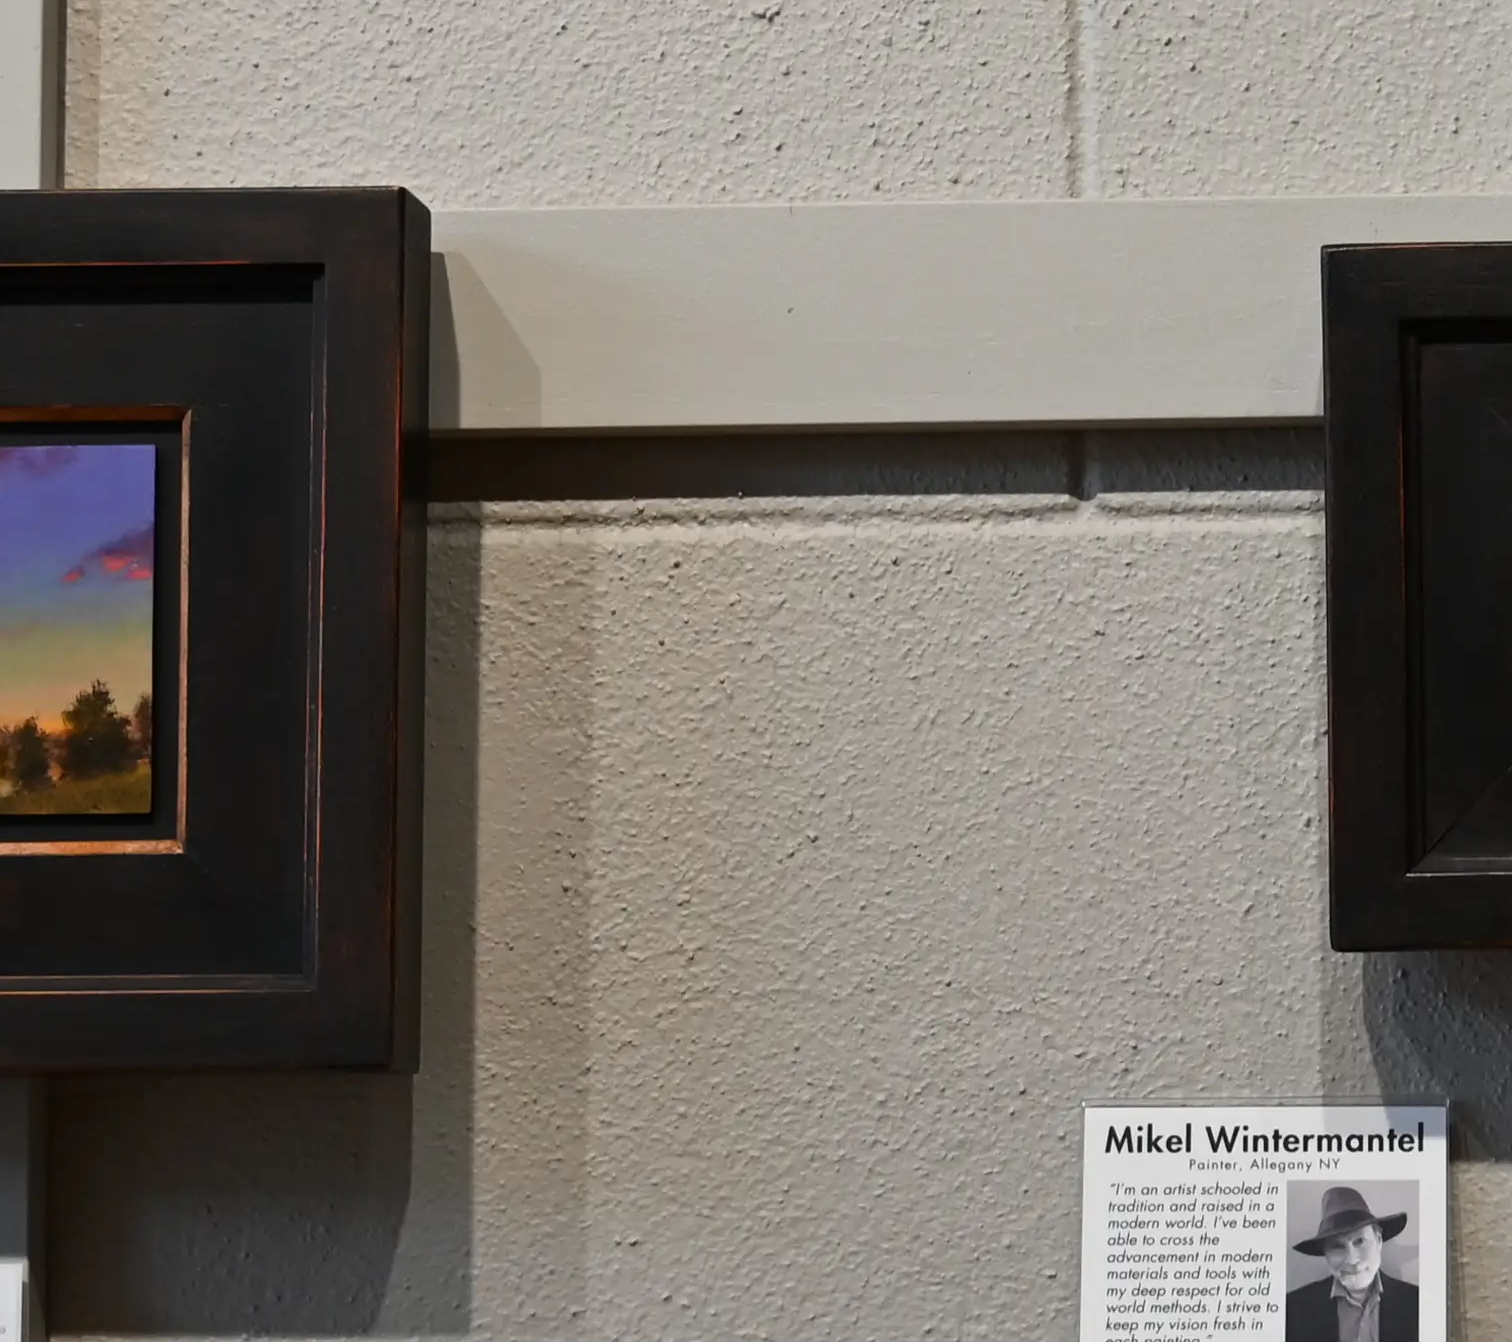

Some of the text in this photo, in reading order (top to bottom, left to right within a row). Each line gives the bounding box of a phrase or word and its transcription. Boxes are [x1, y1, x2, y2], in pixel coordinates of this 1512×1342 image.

[1104, 1122, 1424, 1153] Mikel Wintermantel
[1189, 1157, 1340, 1173] Painter, Allegany NY
[1140, 1186, 1158, 1195] an
[1163, 1183, 1196, 1195] artist
[1200, 1181, 1262, 1195] schooled
[1266, 1183, 1278, 1195] in
[1108, 1197, 1274, 1212] tradition and raised in a
[1108, 1215, 1159, 1229] modern
[1165, 1214, 1206, 1229] world.
[1242, 1214, 1275, 1228] been
[1107, 1231, 1219, 1246] able to cross the
[1106, 1248, 1272, 1263] advancement in modern
[1107, 1265, 1269, 1280] materials and tools with
[1106, 1281, 1271, 1300] my deep respect for old
[1106, 1299, 1279, 1313] world methods. I strive to
[1105, 1315, 1263, 1334] keep my vision fresh in
